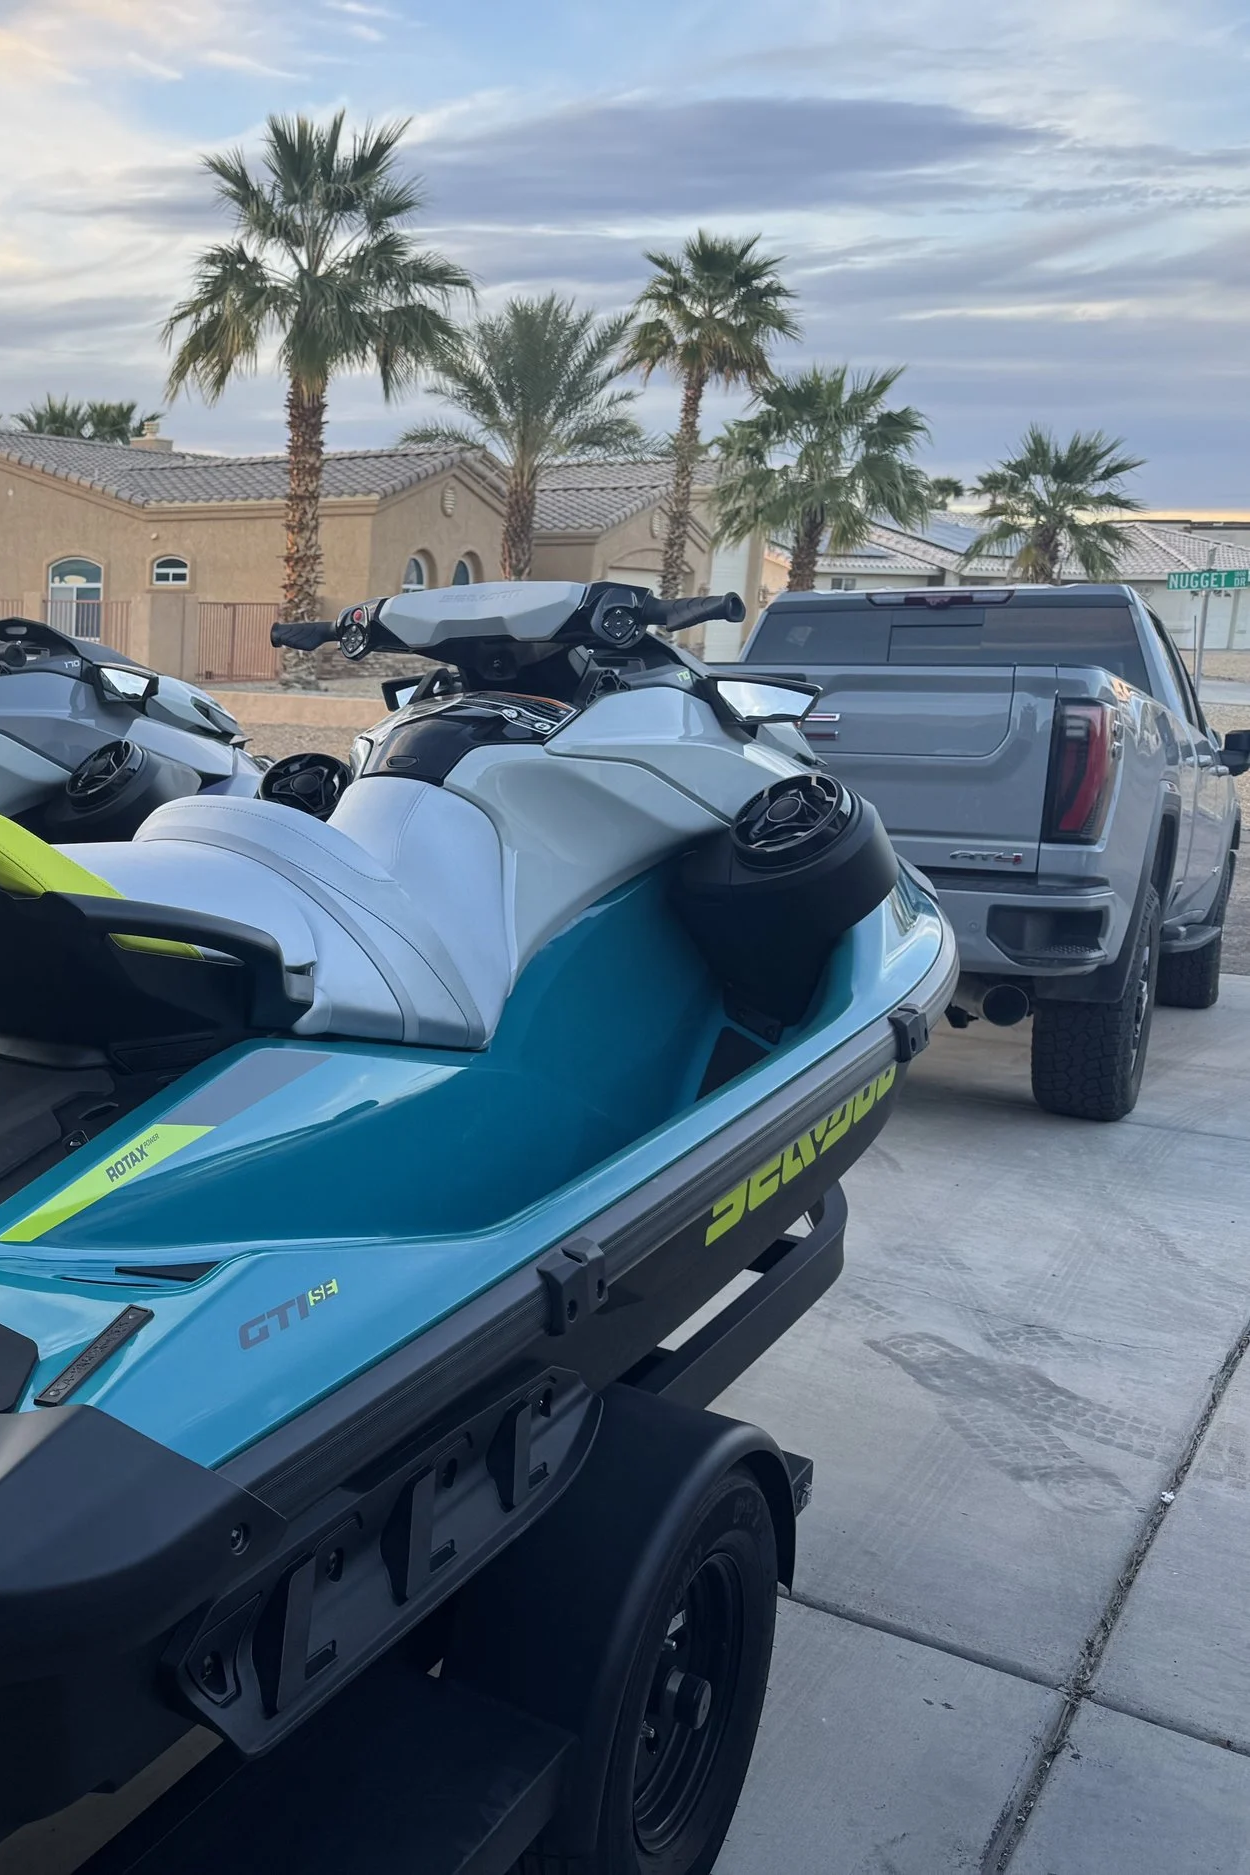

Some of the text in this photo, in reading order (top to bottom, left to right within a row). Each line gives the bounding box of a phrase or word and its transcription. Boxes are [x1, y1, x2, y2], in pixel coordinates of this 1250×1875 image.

[1169, 572, 1246, 589] NUGGET DR
[64, 660, 80, 669] 170
[676, 670, 690, 682] 170
[105, 1133, 160, 1183] ROTAX POWER
[238, 1279, 339, 1350] GTI SE
